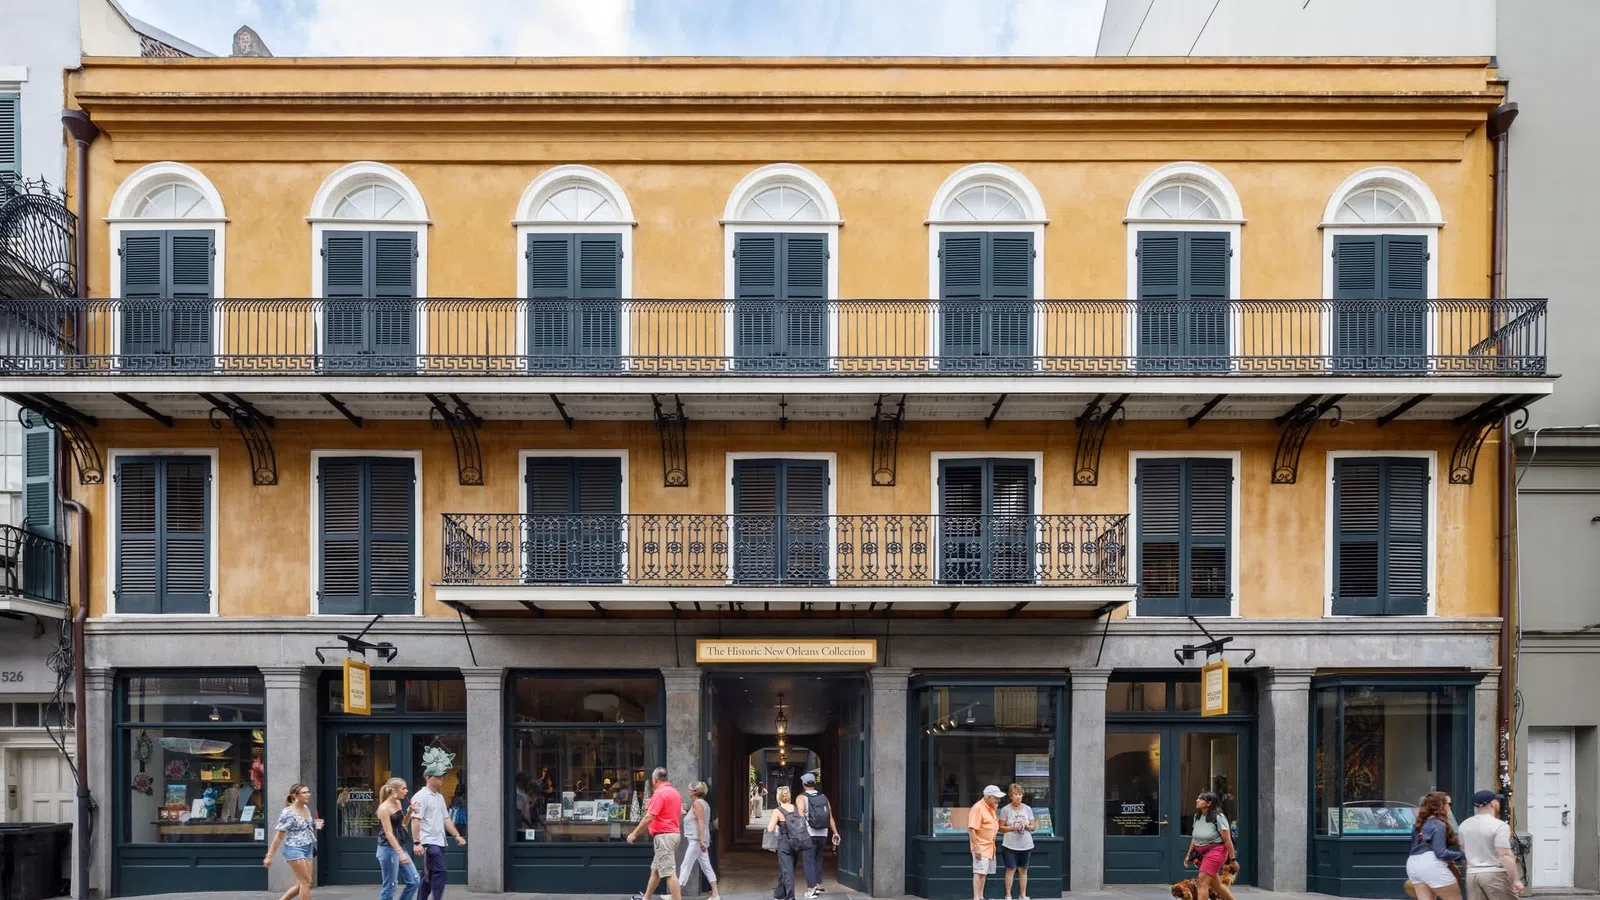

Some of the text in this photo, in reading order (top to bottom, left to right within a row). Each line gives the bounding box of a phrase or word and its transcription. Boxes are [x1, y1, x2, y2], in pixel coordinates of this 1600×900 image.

[706, 646, 866, 656] The Historic New Orleans Collection
[2, 671, 24, 682] 526
